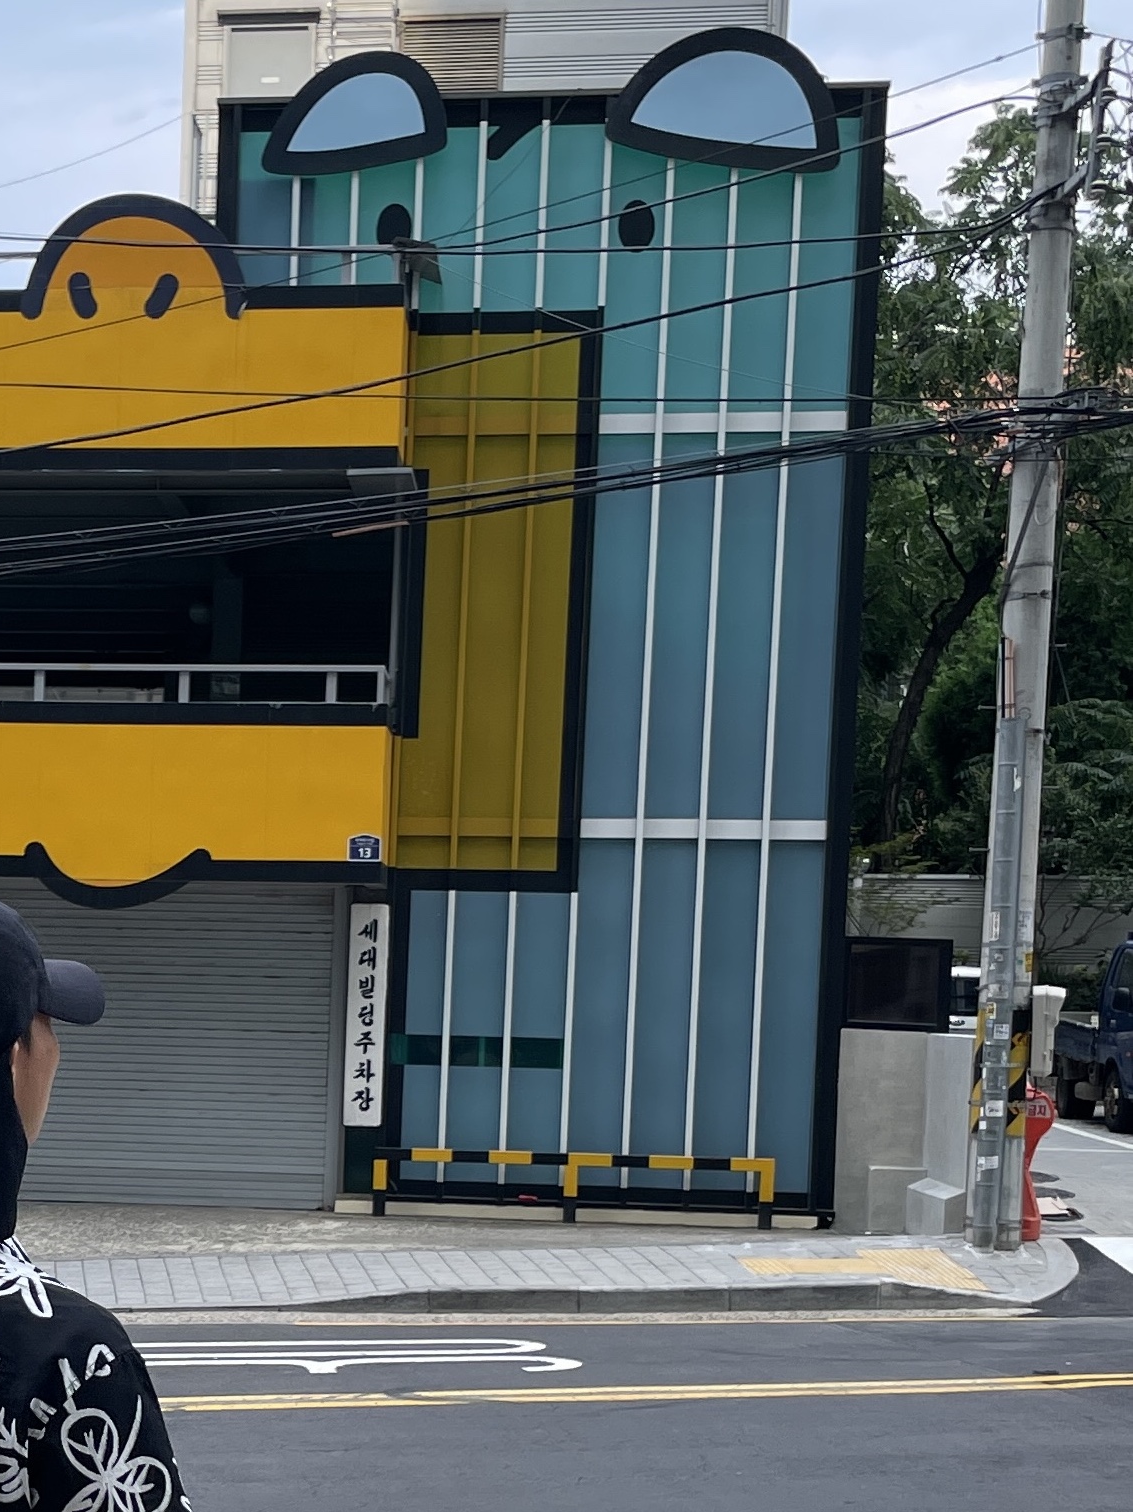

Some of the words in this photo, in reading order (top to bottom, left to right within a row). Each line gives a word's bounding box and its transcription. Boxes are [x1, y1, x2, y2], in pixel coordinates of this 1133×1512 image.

[358, 847, 372, 859] 13
[351, 918, 379, 1112] 세대빌딩주차장
[1027, 1104, 1047, 1117] 금지
